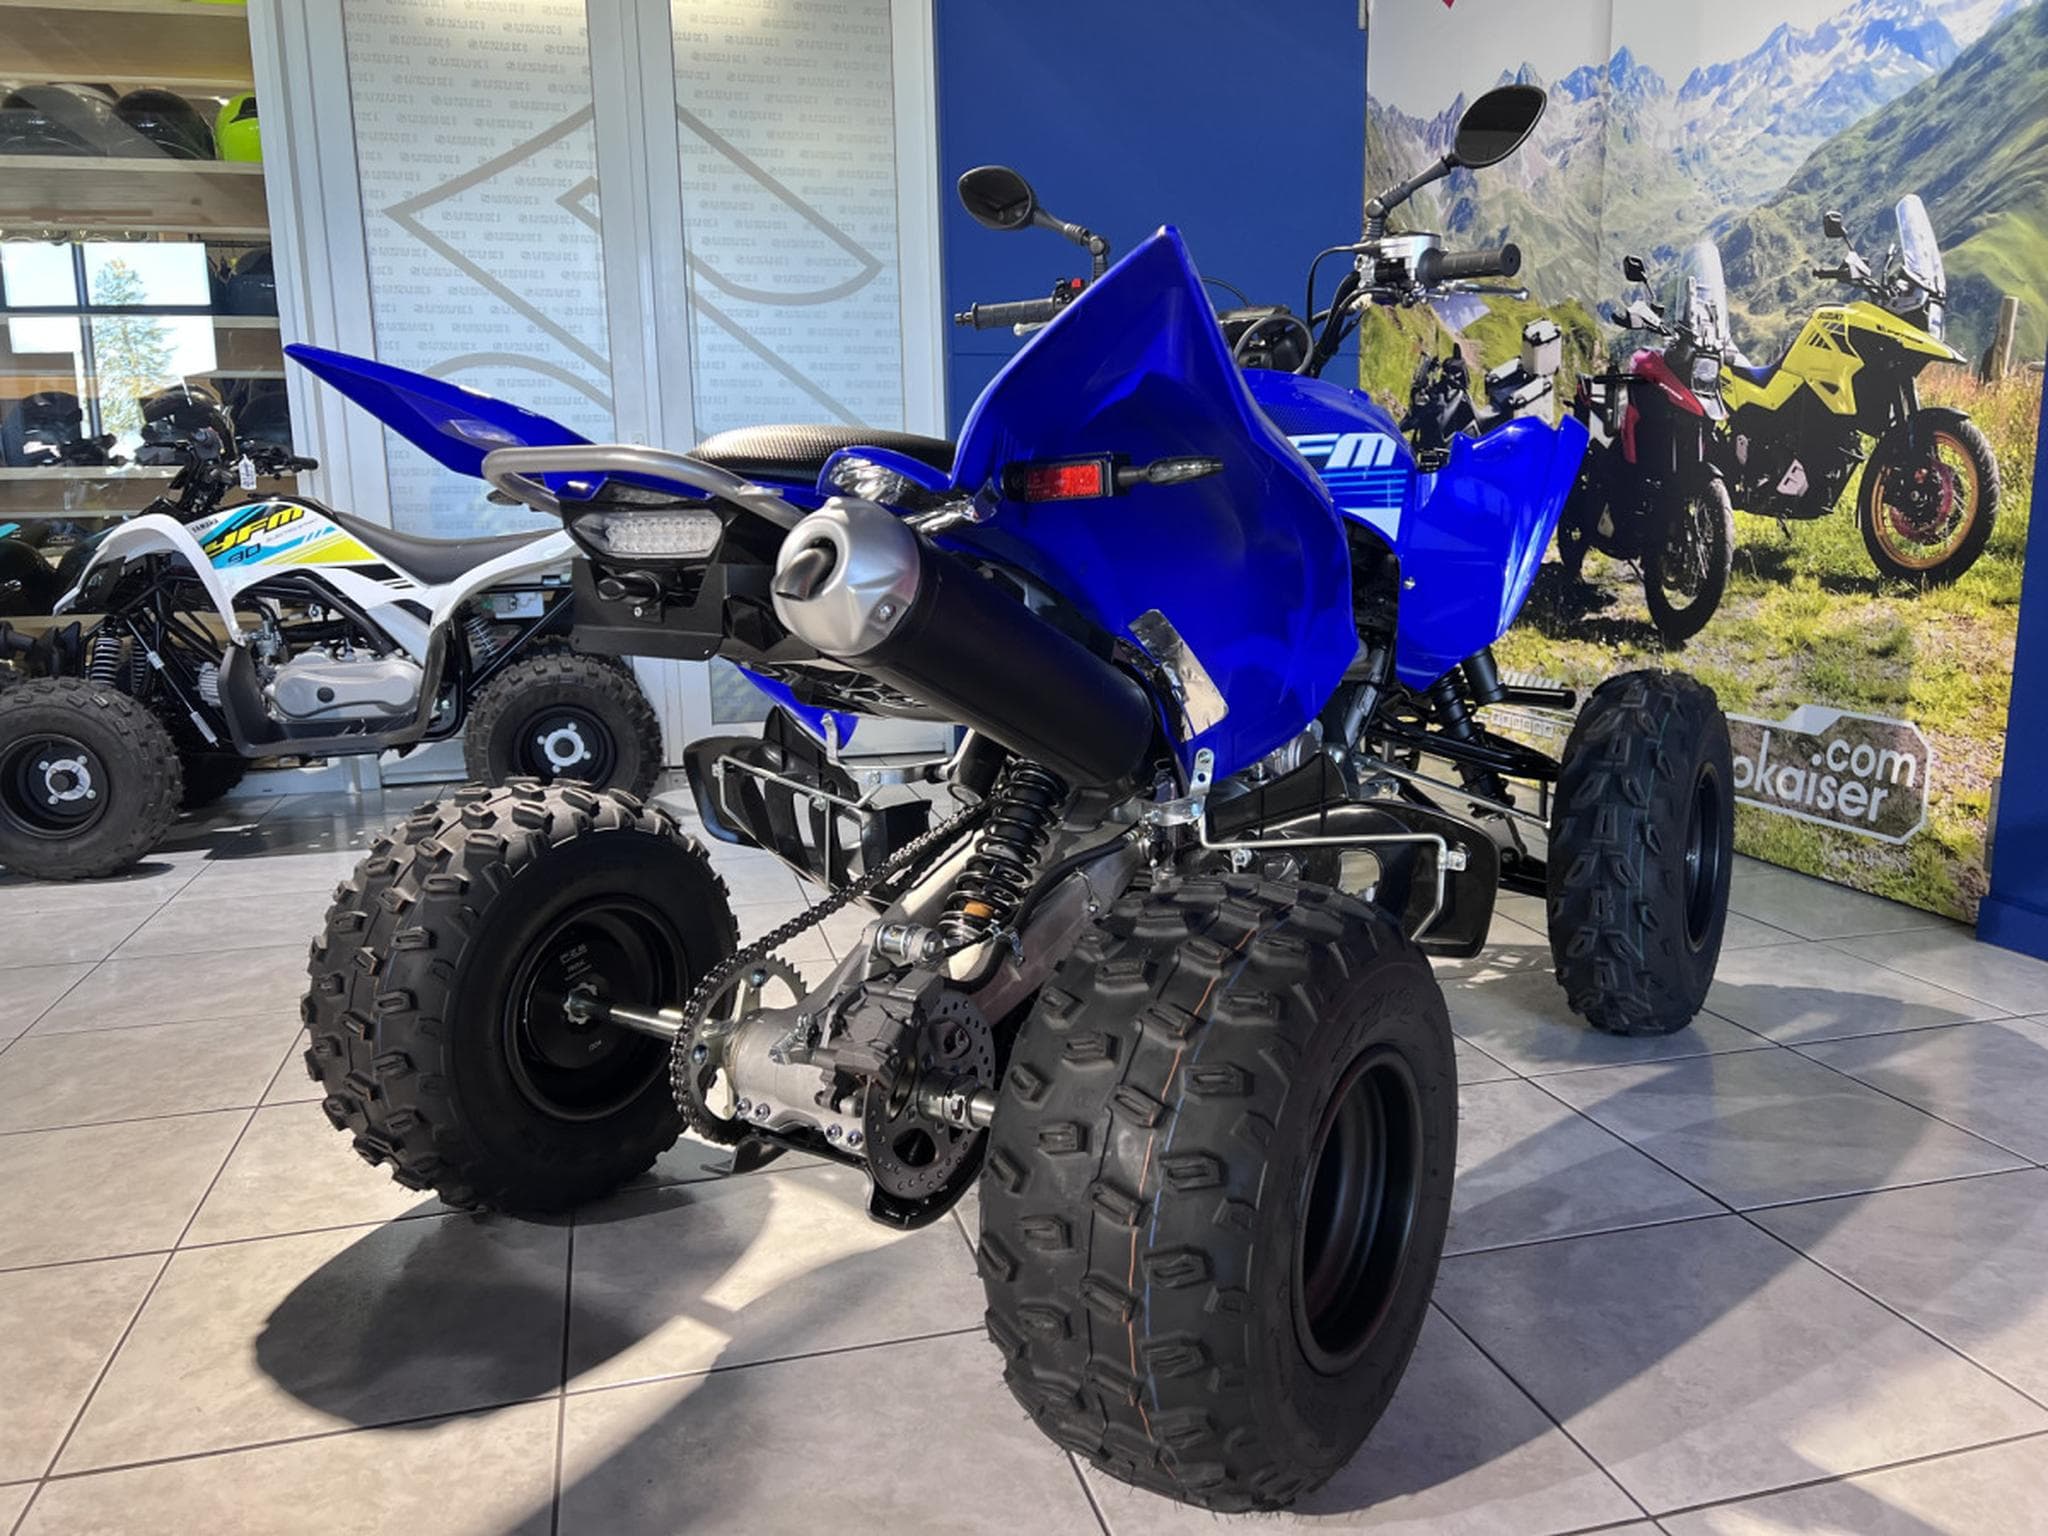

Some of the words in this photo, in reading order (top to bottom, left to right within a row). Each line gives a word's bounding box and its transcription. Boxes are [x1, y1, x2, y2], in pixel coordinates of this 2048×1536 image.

[1286, 432, 1398, 470] FM
[204, 505, 305, 559] YFM
[228, 542, 261, 563] 90
[1733, 730, 1889, 822] okaiser
[1811, 738, 1917, 787] .com
